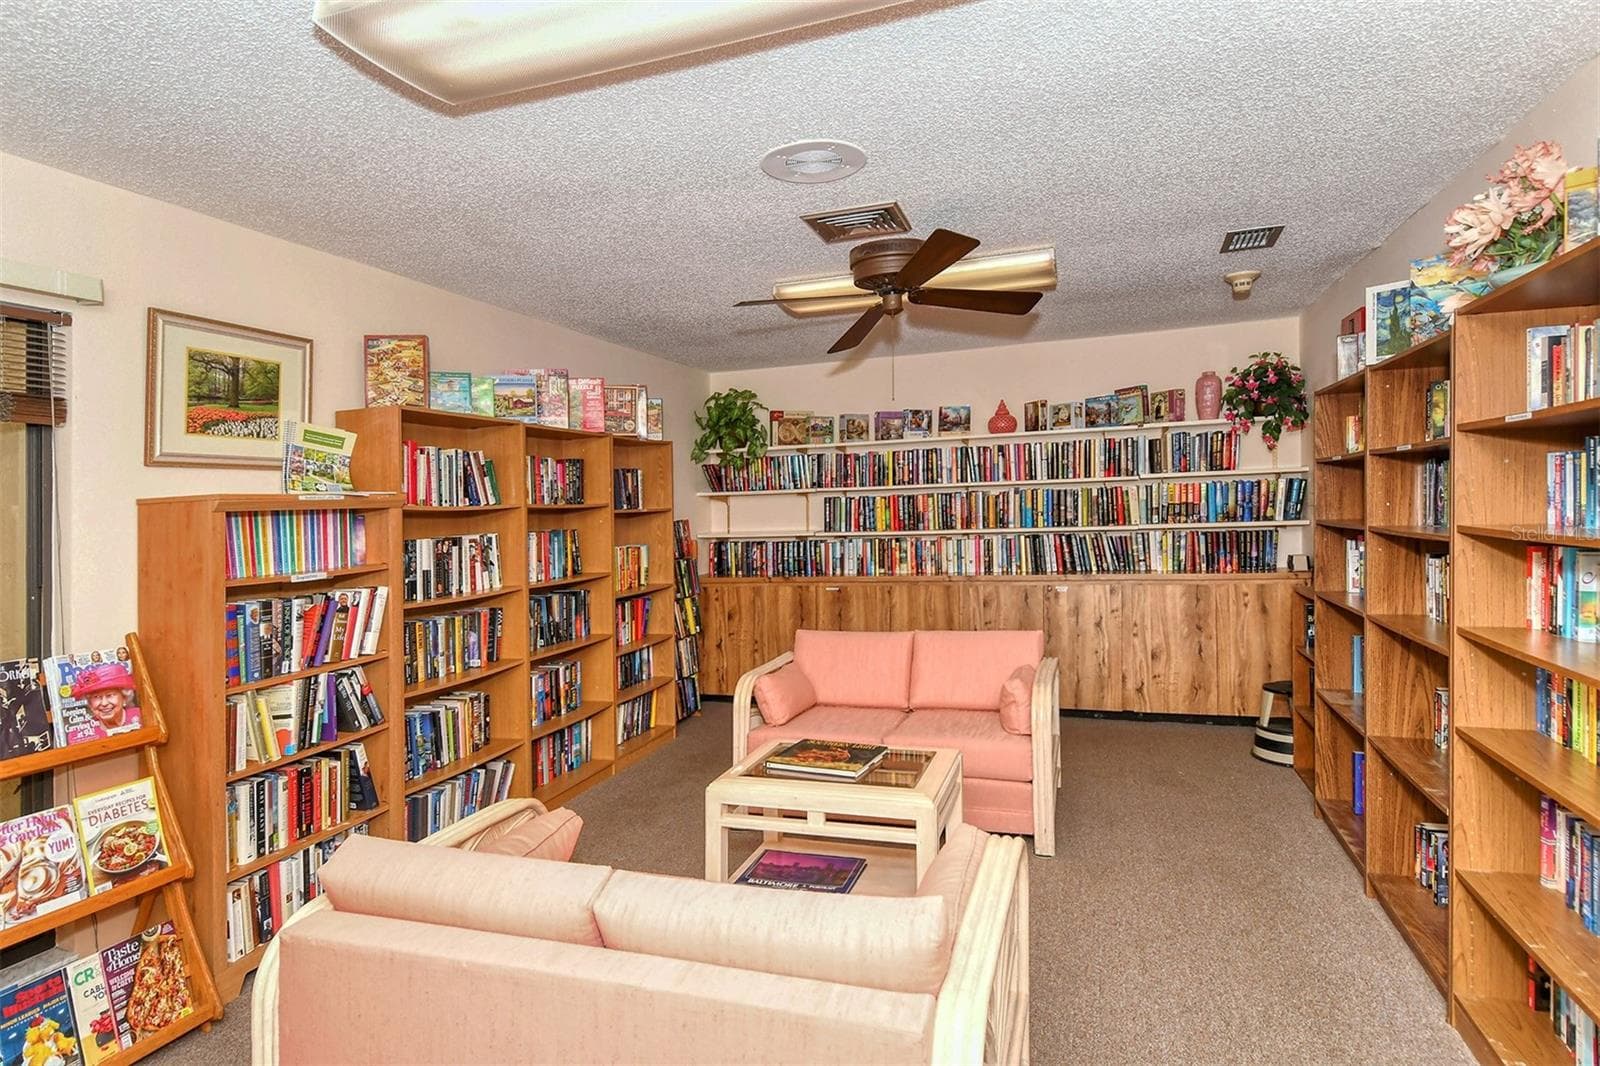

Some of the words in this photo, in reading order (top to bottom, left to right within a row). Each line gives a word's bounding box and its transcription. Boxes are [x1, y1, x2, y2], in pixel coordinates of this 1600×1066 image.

[62, 707, 87, 718] Keeping
[69, 713, 85, 723] Calm
[64, 720, 90, 733] Carrying
[87, 803, 114, 816] EVERYDAY
[115, 797, 136, 808] RECIPES
[136, 793, 146, 801] FOR
[88, 798, 149, 827] DIABETES
[0, 822, 24, 835] tter
[26, 810, 69, 828] Homes
[9, 824, 62, 845] Gardens
[48, 837, 74, 854] YUM!
[747, 877, 799, 888] BALTIMORE
[103, 941, 139, 961] Taste
[111, 953, 141, 970] Home
[74, 967, 95, 986] CR
[83, 983, 105, 998] CABL
[93, 991, 105, 1001] YO
